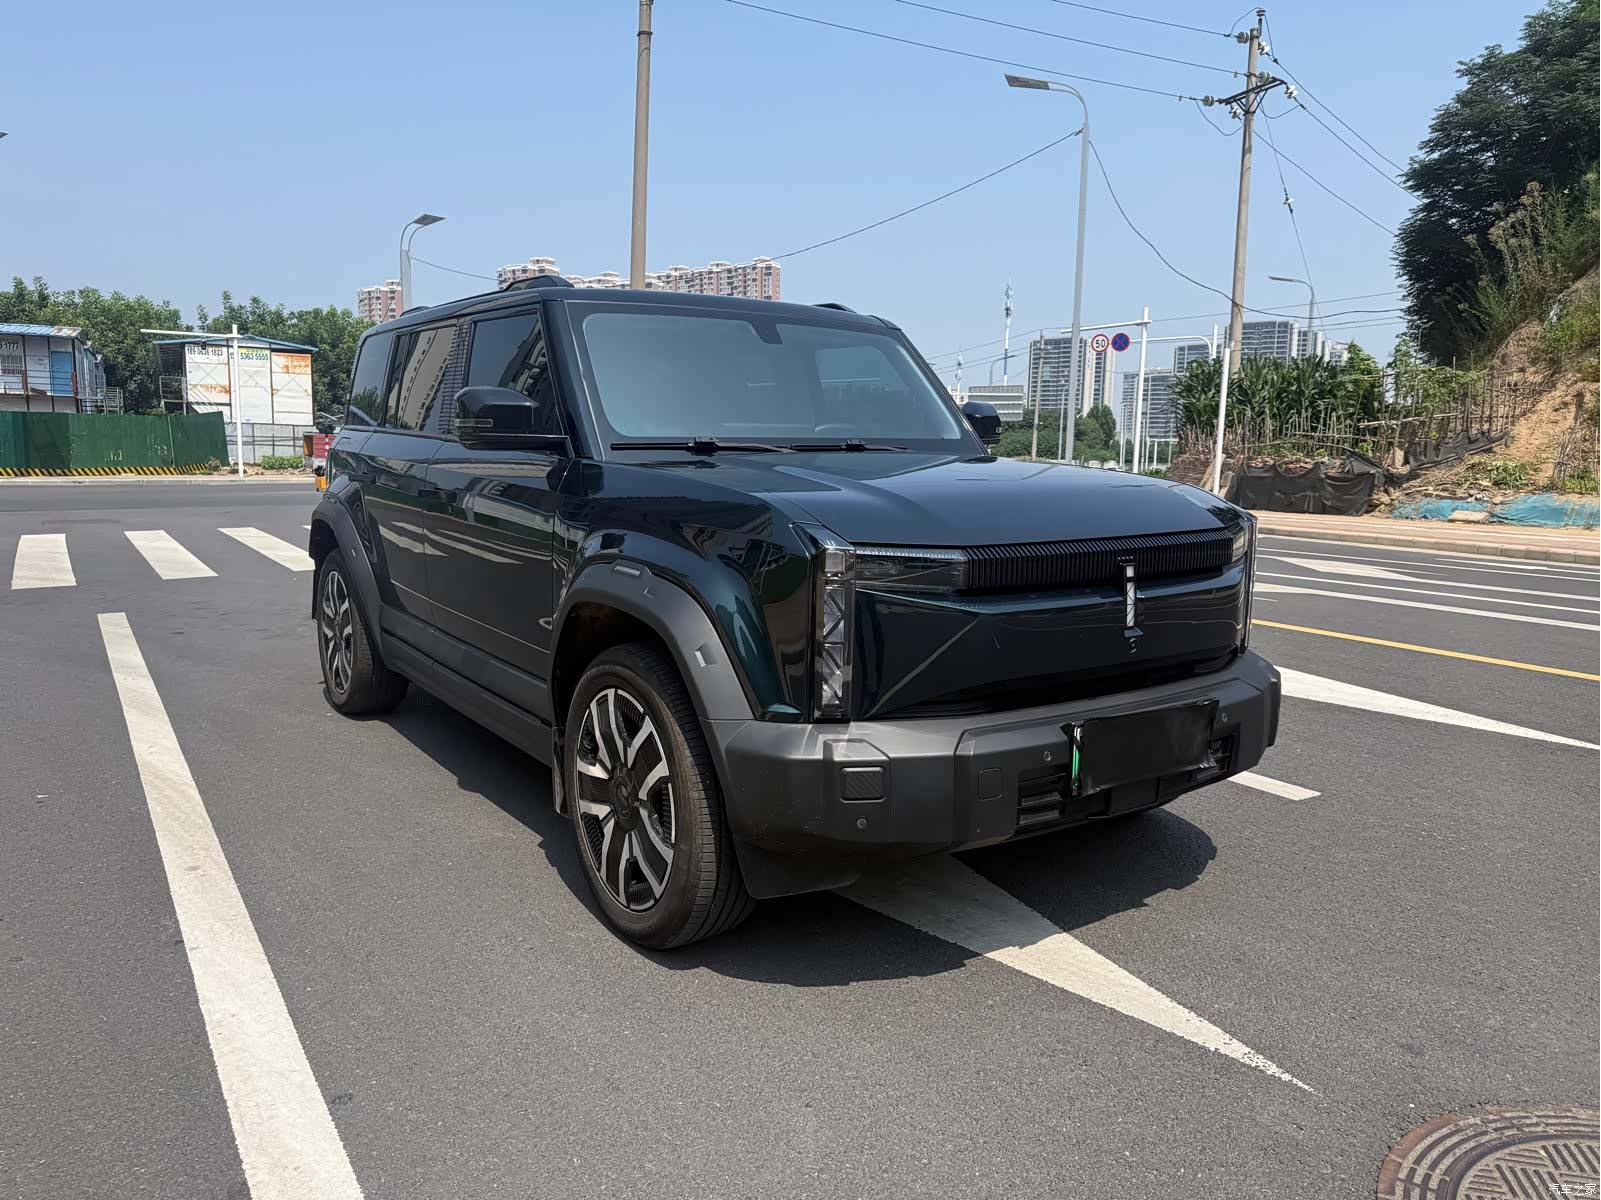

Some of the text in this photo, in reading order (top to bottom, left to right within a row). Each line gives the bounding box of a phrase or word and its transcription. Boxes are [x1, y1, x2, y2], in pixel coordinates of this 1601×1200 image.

[1095, 339, 1105, 348] 50
[187, 347, 196, 355] 189
[211, 349, 223, 357] 1823
